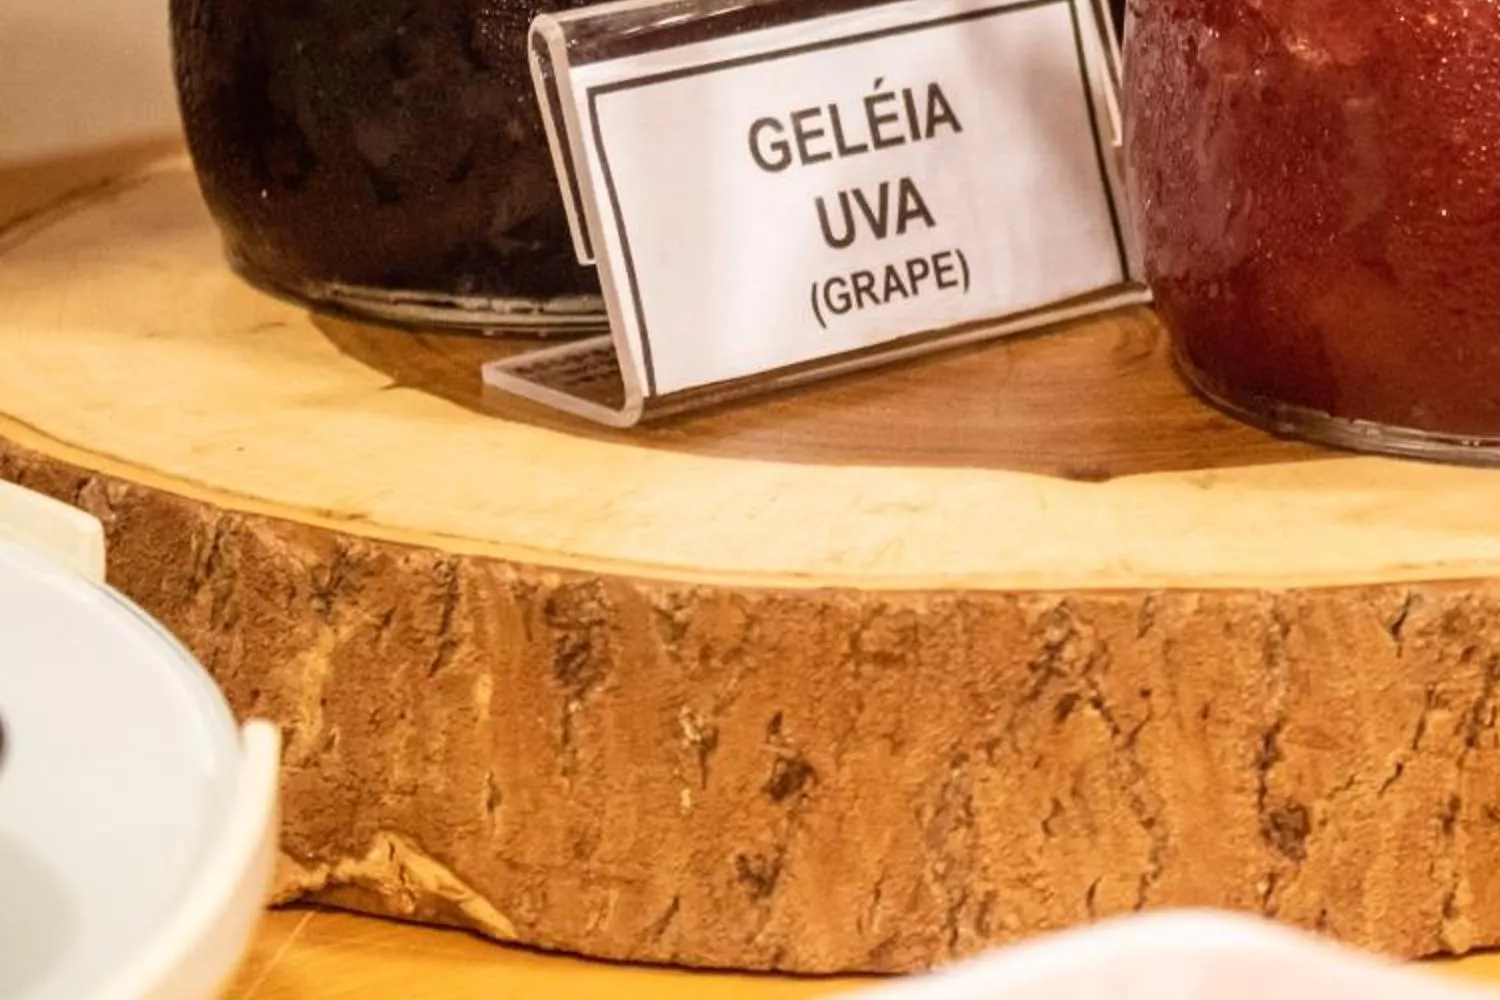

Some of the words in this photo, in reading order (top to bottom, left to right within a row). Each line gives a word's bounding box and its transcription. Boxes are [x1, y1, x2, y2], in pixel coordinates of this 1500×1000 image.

[747, 77, 963, 172] GELÉIA
[814, 177, 935, 249] UVA
[811, 249, 970, 328] (GRAPE)
